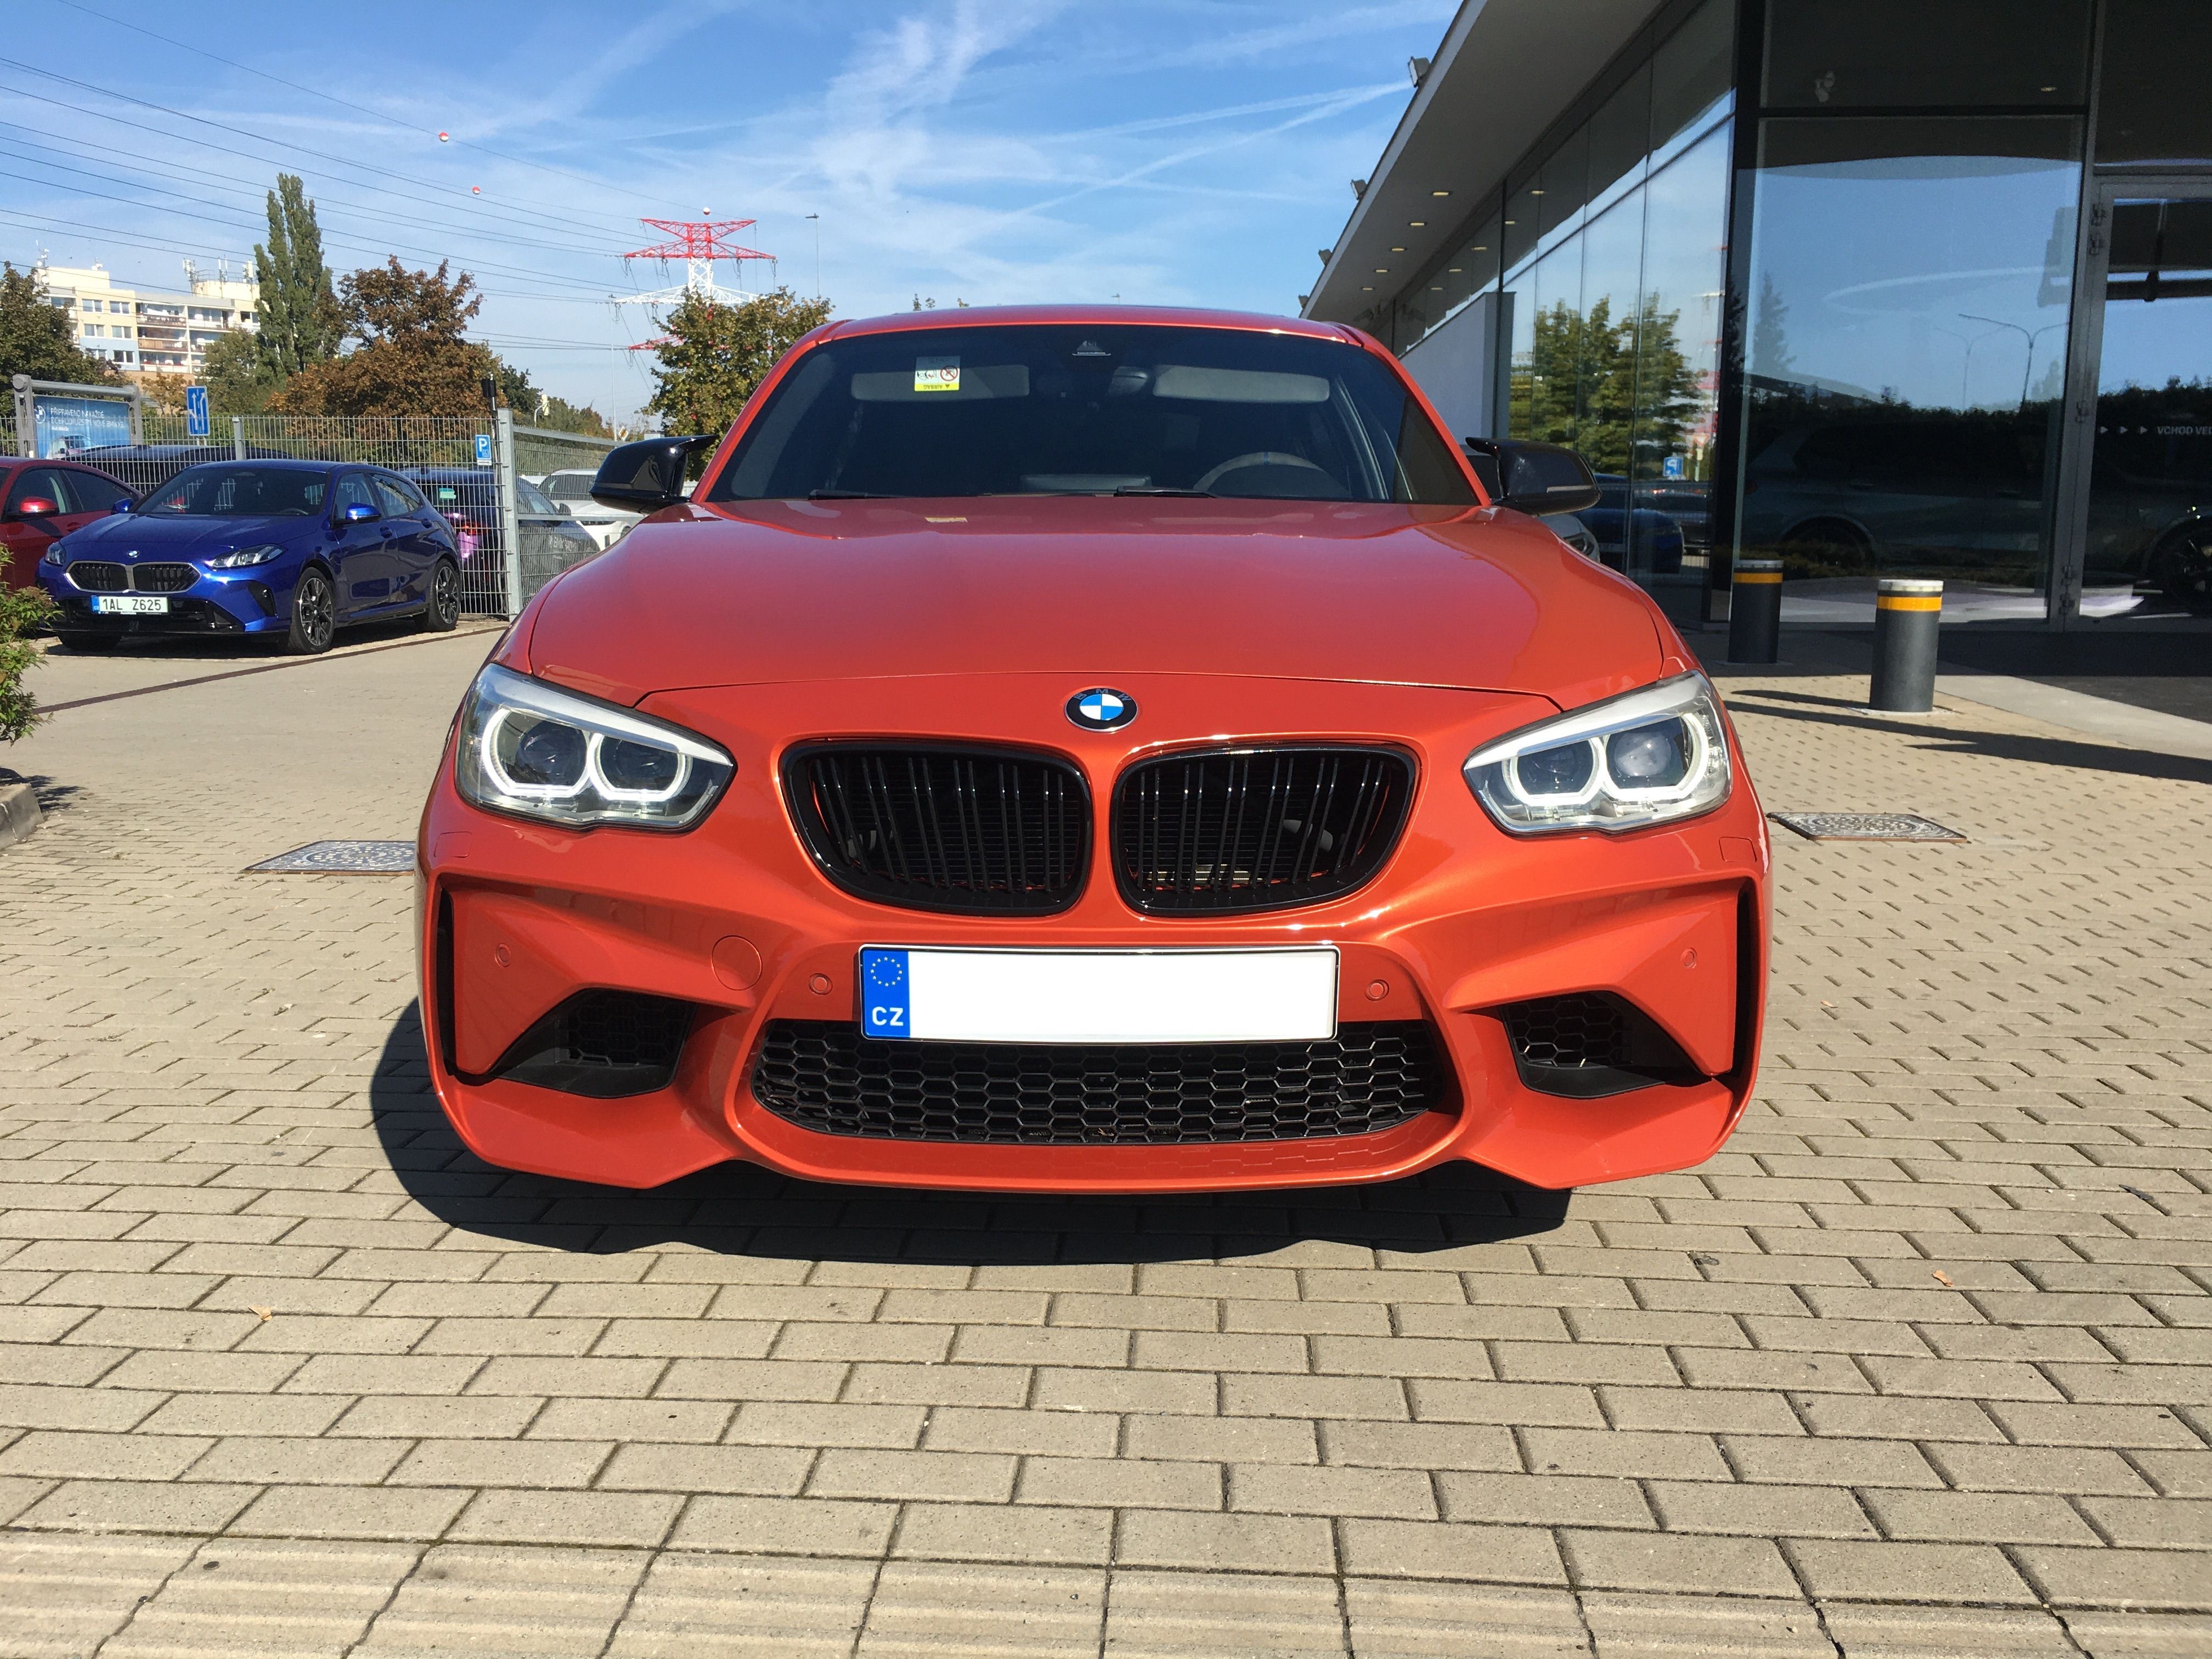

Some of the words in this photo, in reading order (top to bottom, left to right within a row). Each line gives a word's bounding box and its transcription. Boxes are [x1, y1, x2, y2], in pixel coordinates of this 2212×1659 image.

[2157, 426, 2193, 435] VCHOD
[479, 438, 488, 452] P
[103, 599, 123, 610] 1AL
[132, 599, 161, 611] Z625
[1074, 689, 1132, 702] BMW
[872, 1006, 904, 1026] CZ
